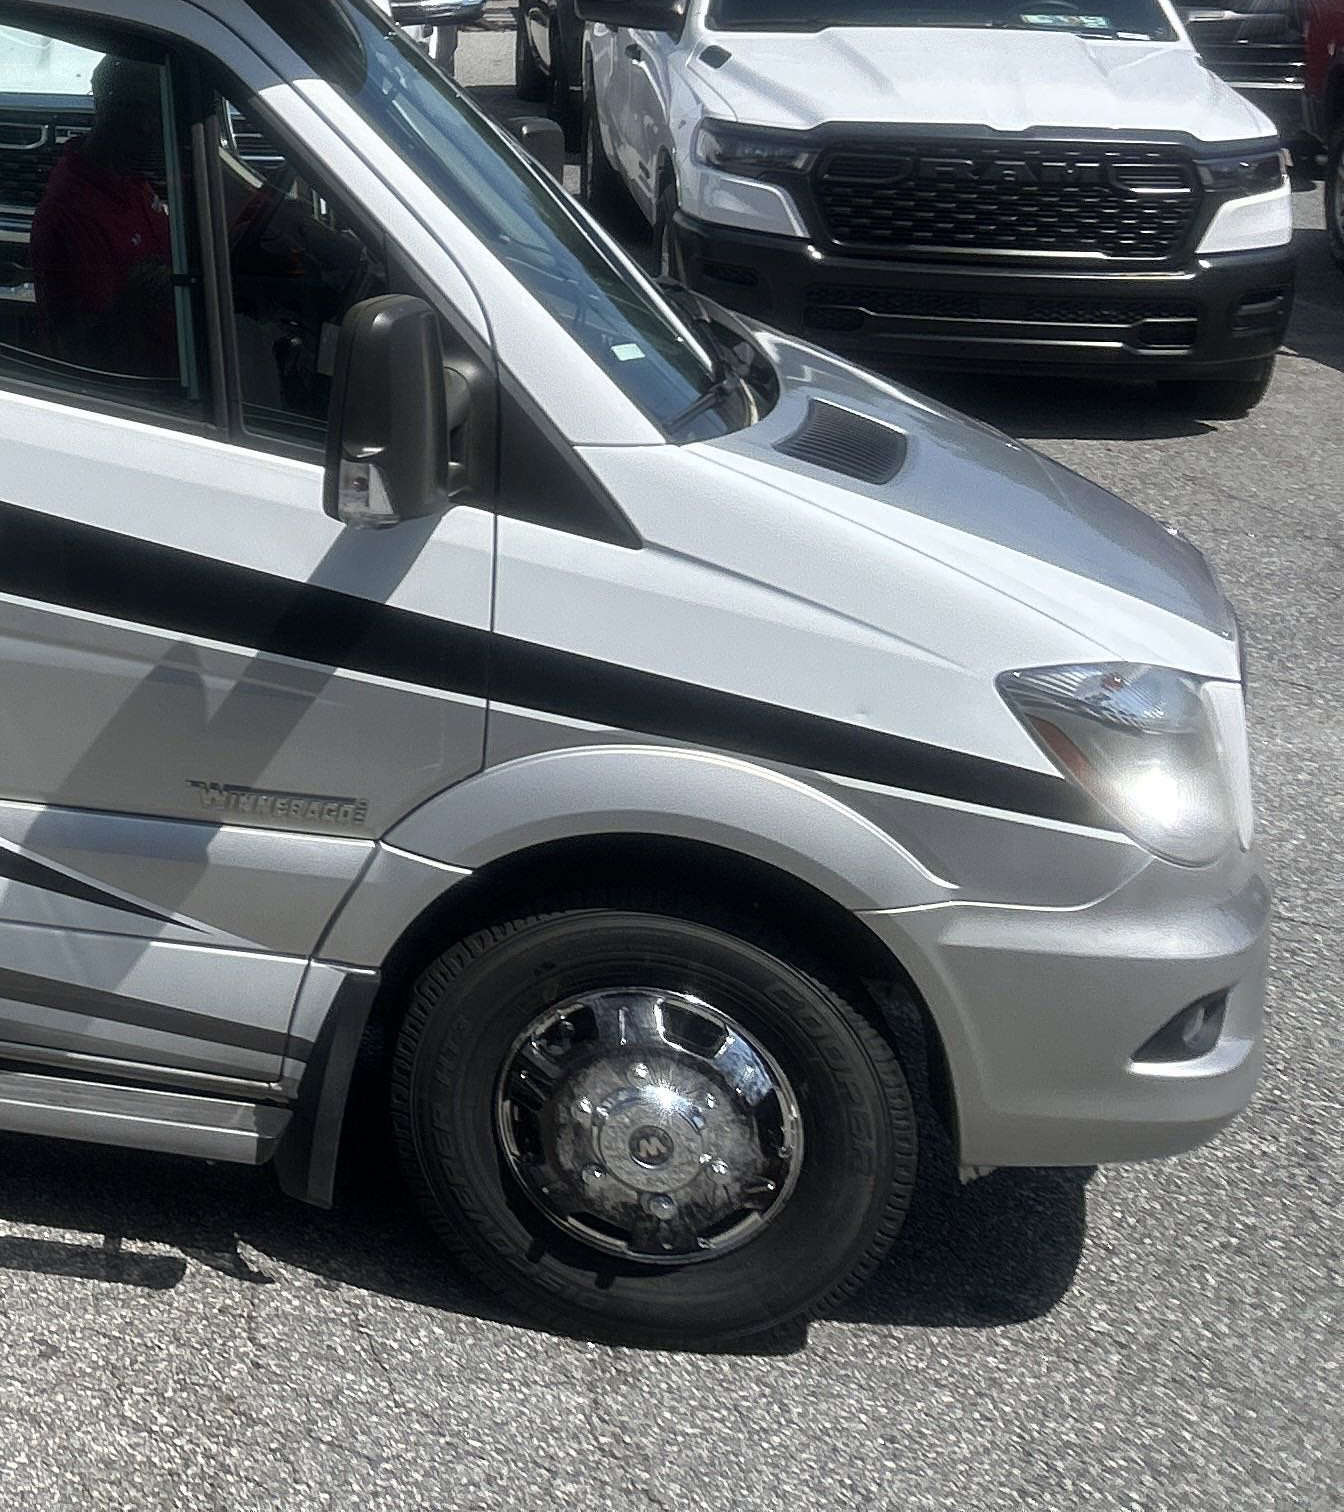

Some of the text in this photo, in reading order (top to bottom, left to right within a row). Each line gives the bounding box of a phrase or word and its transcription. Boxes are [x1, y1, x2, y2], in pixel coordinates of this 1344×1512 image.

[917, 157, 1103, 183] RAM
[185, 779, 356, 823] WINNEBAGO
[764, 981, 875, 1176] COOPER
